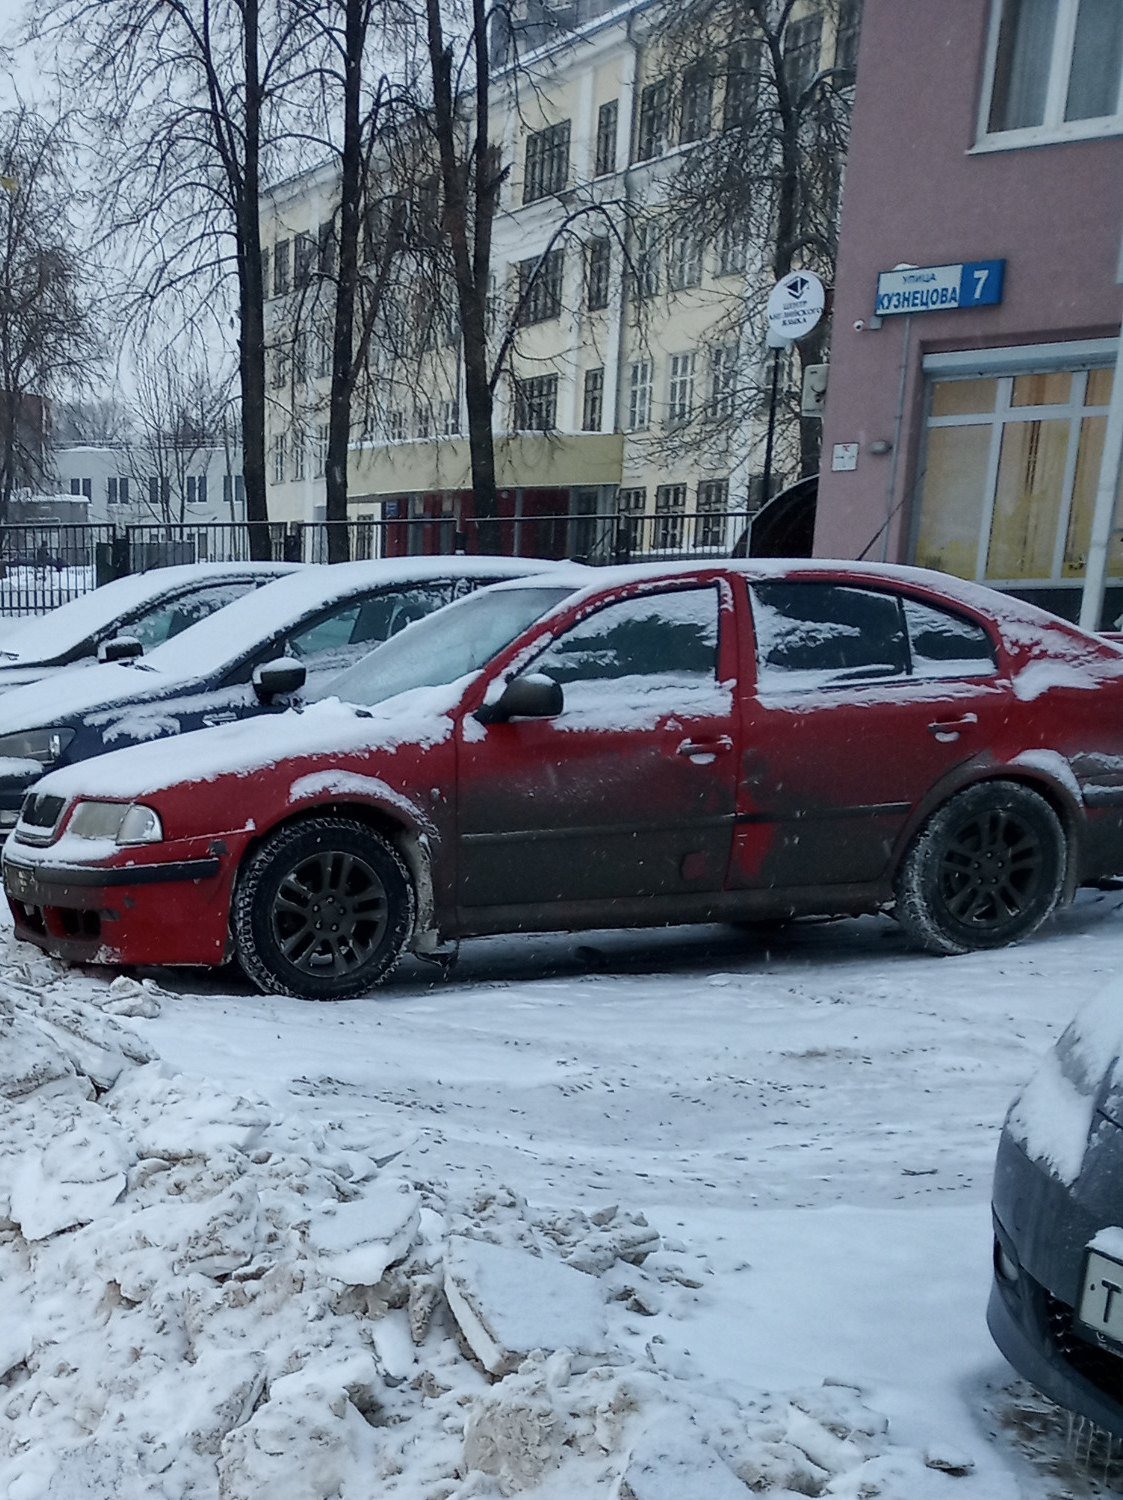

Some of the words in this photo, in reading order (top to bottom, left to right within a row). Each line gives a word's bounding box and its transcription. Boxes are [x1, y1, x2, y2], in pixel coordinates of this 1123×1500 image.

[902, 273, 937, 284] УЛИЦА
[973, 269, 990, 300] 7
[876, 287, 958, 310] КУЗНЕЦОВА
